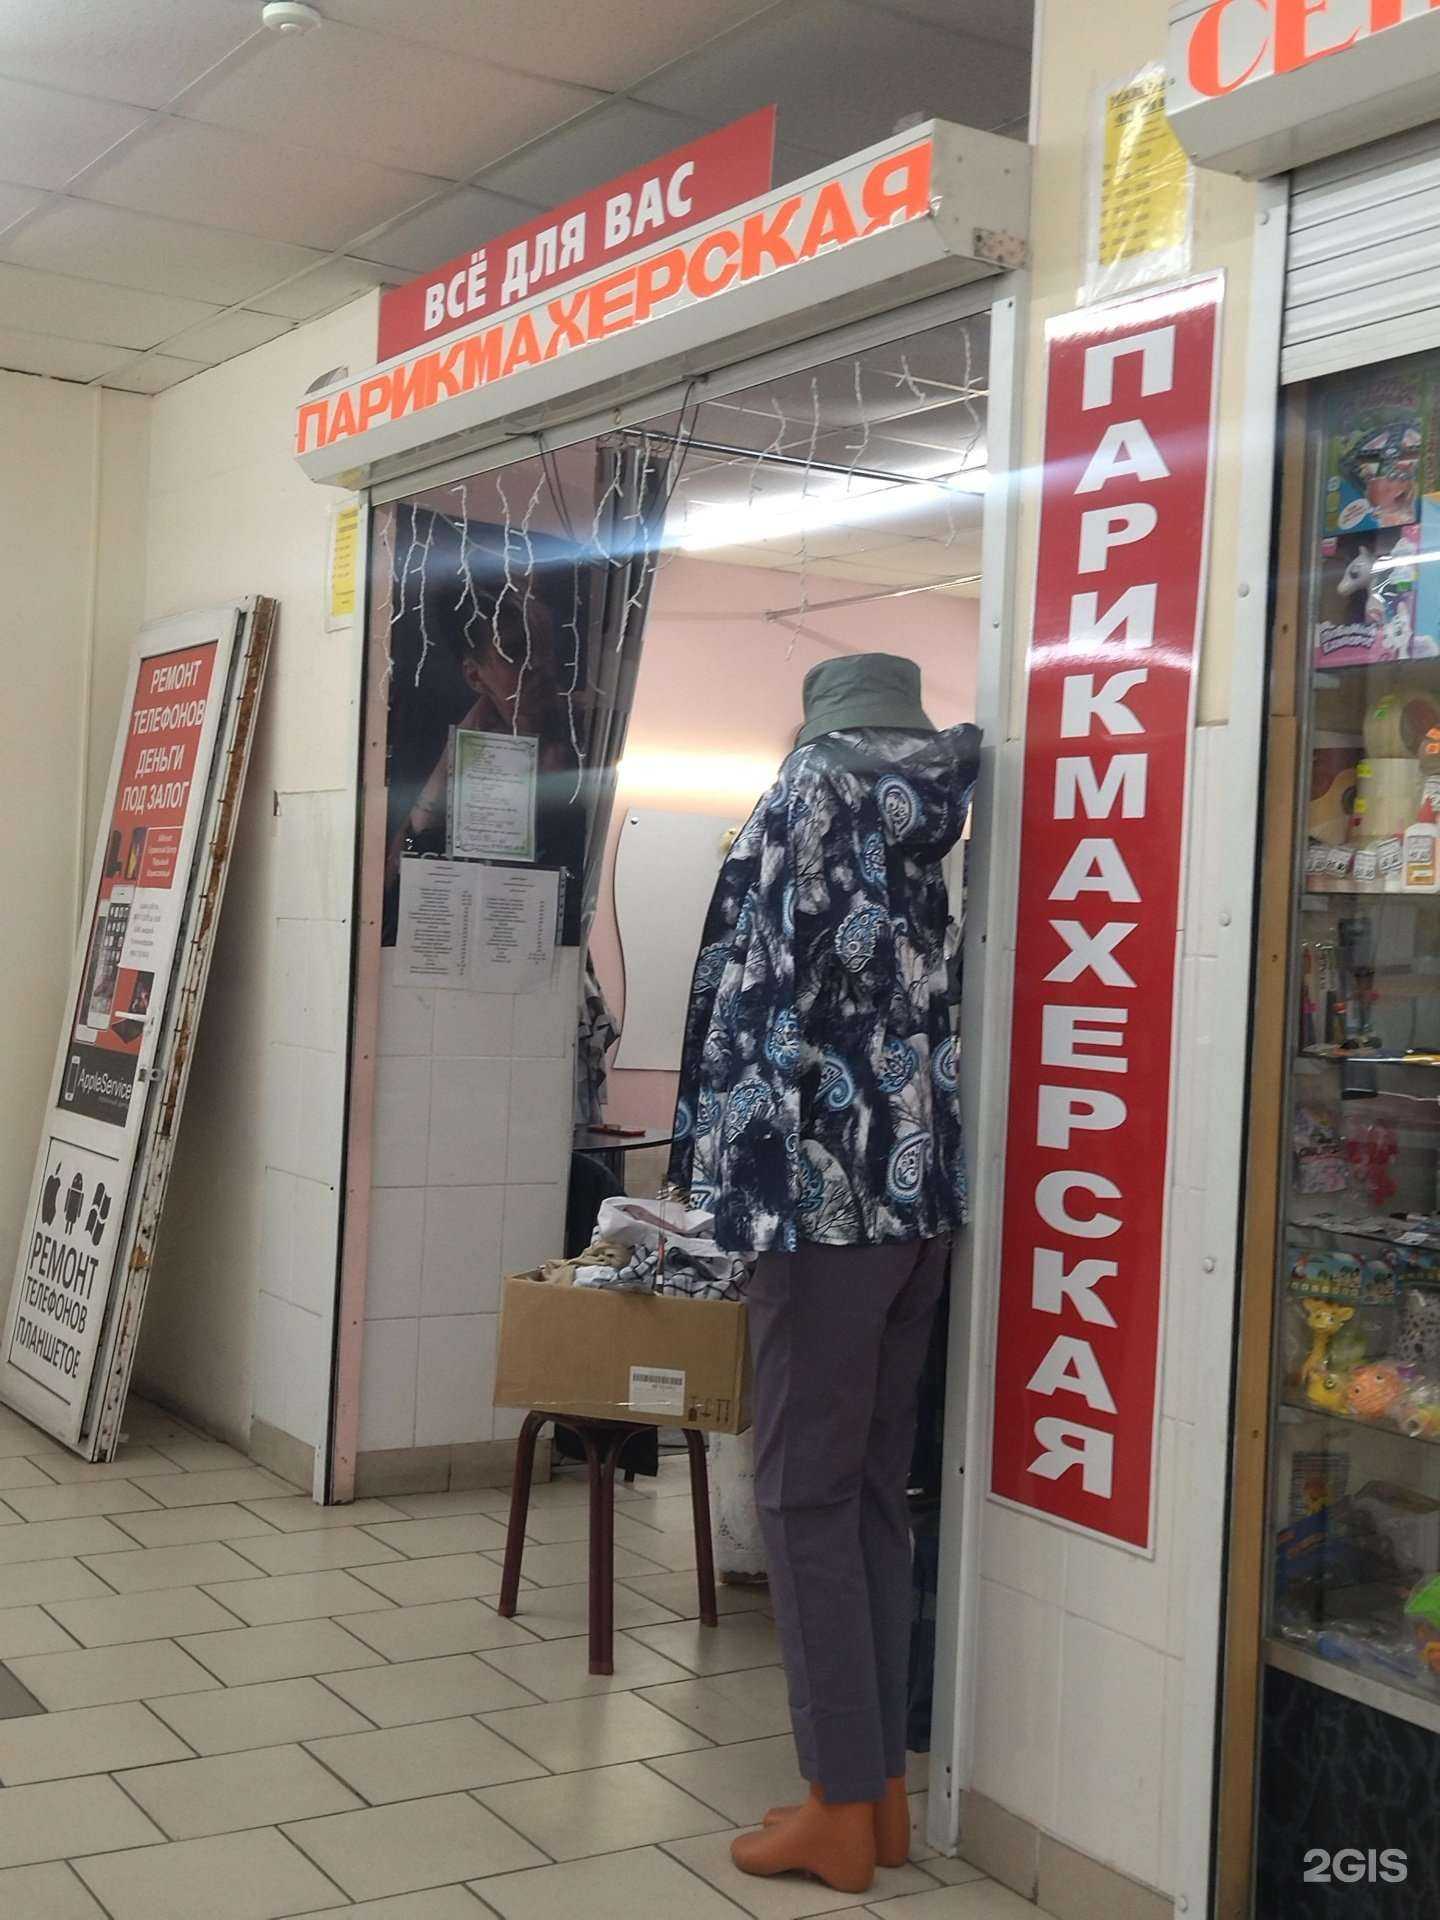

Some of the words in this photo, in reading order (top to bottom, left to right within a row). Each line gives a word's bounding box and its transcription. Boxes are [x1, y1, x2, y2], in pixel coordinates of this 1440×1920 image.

[423, 253, 488, 331] ВСЁ
[500, 211, 586, 306] ДЛЯ
[604, 161, 695, 251] ВАС
[297, 141, 933, 454] ПАРИКМАХЕРСКАЯ
[150, 659, 202, 694] РЕМОНТ
[132, 699, 207, 735] ТЕЛЕФОНОВ
[134, 744, 185, 779] ДЕНЬГИ
[121, 785, 147, 815] ПОД
[147, 781, 190, 810] ЗАЛОГ
[1025, 324, 1177, 1500] ПАРИКМАХЕРСКАЯ
[78, 1068, 133, 1100] AppleService
[29, 1231, 99, 1300] РЕМОНТ
[25, 1275, 88, 1335] ТЕЛЕФОНОВ
